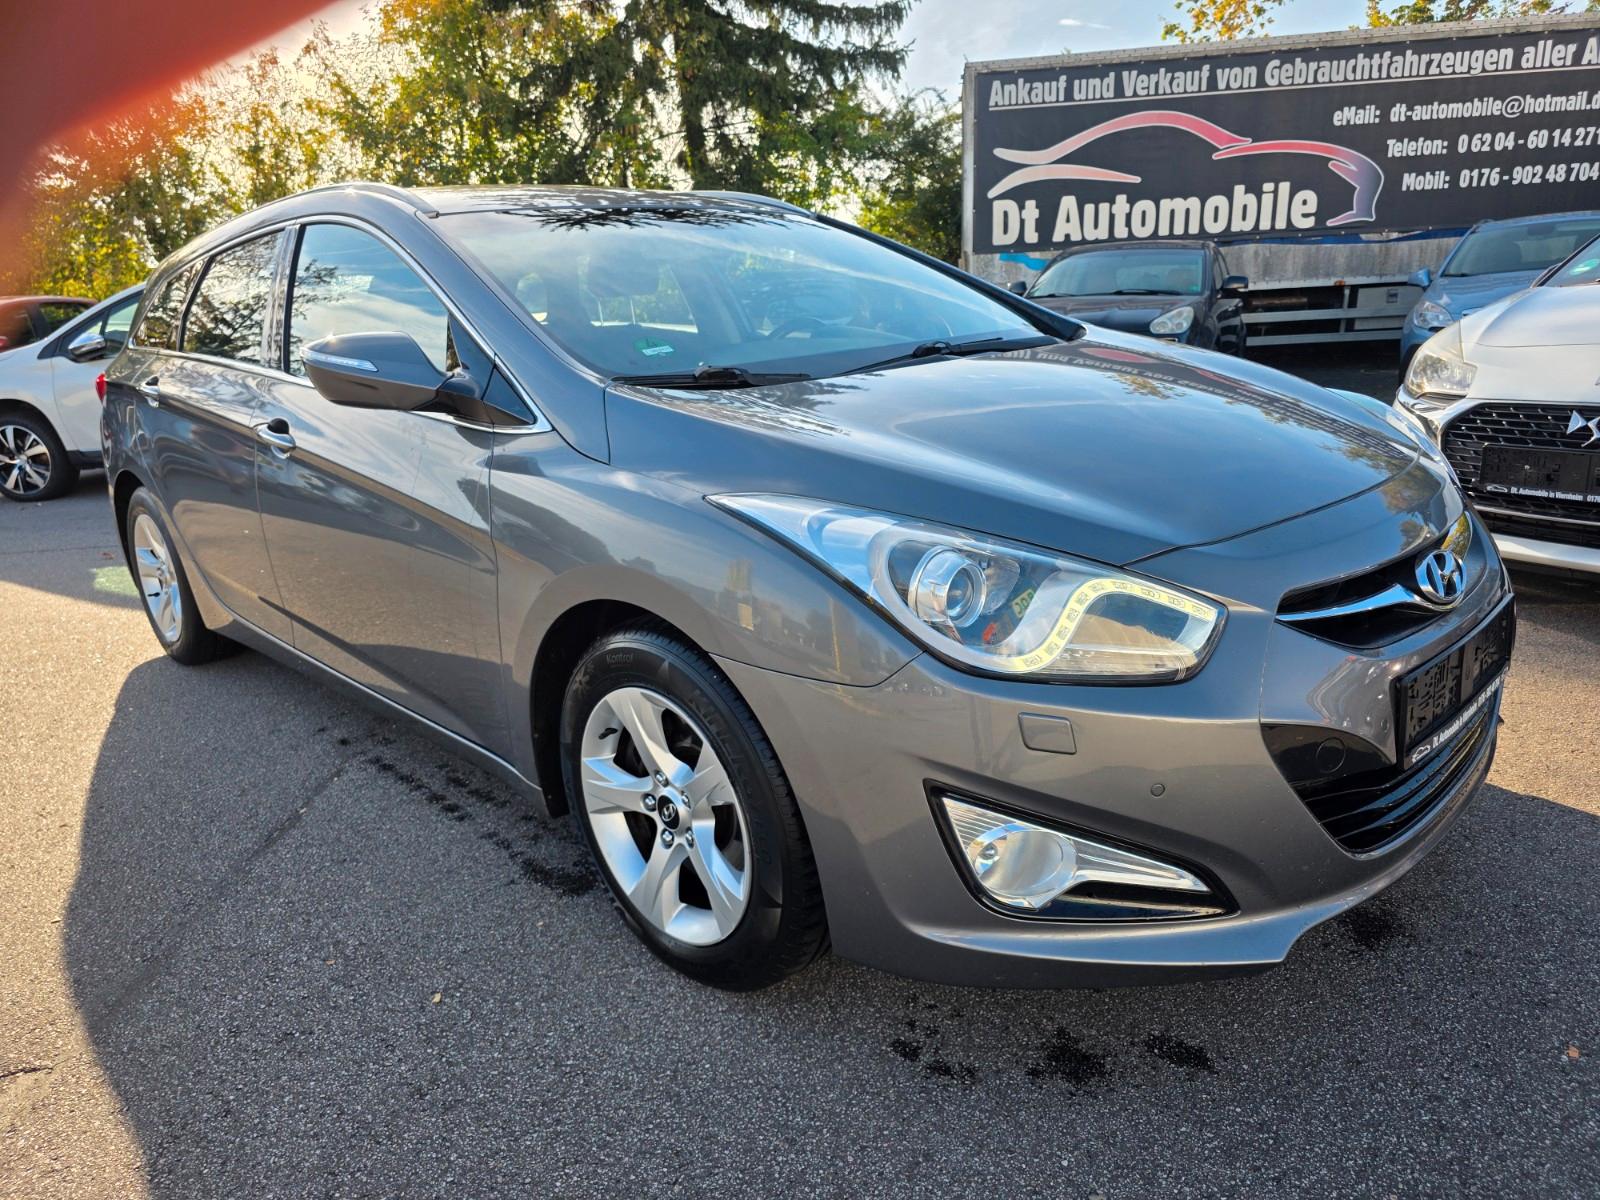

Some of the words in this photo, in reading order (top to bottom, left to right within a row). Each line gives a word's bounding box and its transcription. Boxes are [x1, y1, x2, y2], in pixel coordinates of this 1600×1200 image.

[988, 75, 1068, 107] Ankauf
[1073, 71, 1116, 101] und
[1122, 64, 1211, 96] Verkauf
[1216, 65, 1258, 90] von
[1264, 47, 1515, 87] Gebrauchtfahrzeugen
[1521, 39, 1578, 69] aller
[1580, 36, 1600, 65] A
[1332, 105, 1381, 127] eMail:
[1386, 136, 1449, 158] Telefon:
[1401, 170, 1450, 191] Mobil:
[1459, 166, 1501, 188] 0176
[1511, 164, 1543, 185] 902
[1545, 163, 1567, 183] 48
[991, 198, 1040, 246] Dt
[1051, 181, 1319, 243] Automobile
